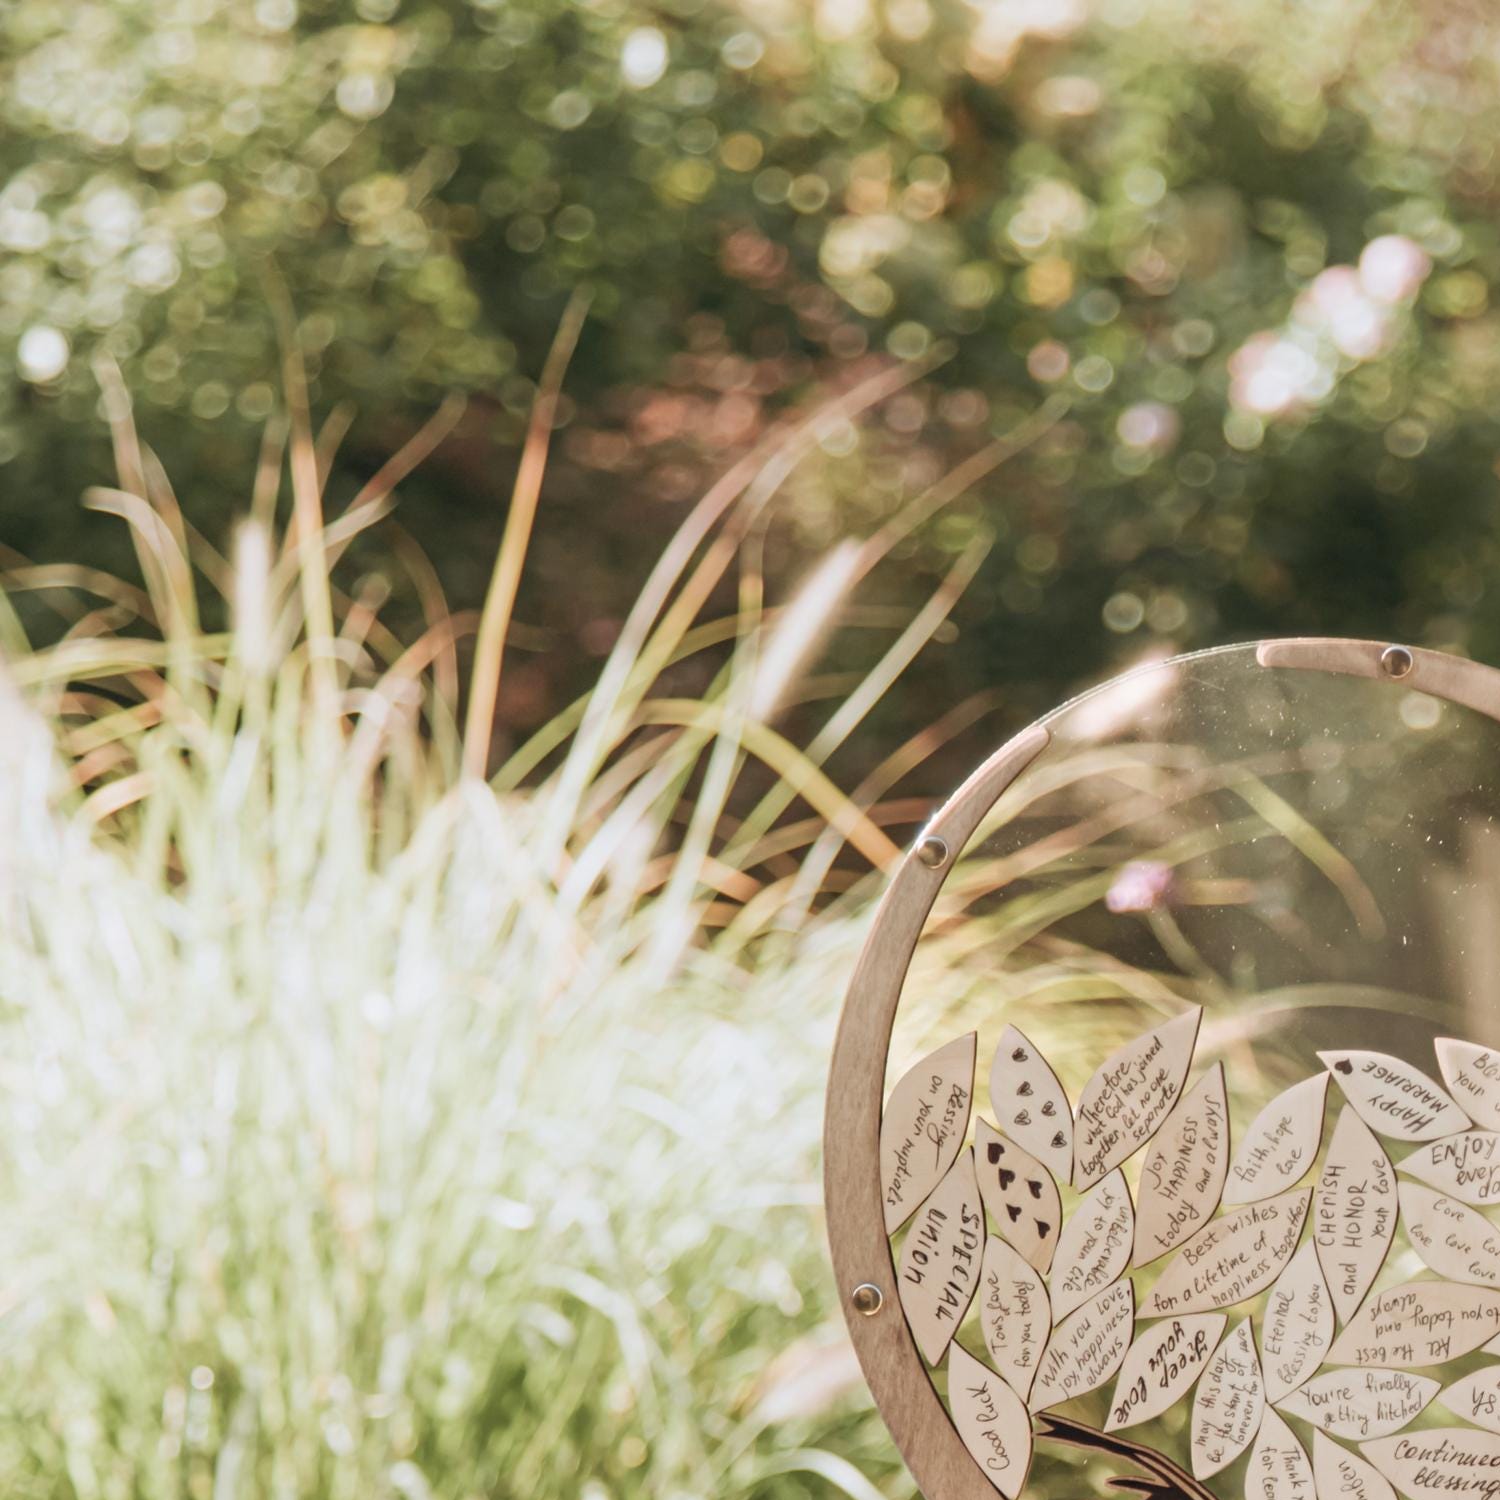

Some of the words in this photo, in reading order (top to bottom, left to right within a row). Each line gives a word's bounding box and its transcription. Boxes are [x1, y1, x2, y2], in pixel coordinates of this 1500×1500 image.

[1138, 1036, 1164, 1083] joined
[929, 1075, 943, 1094] on
[1079, 1061, 1132, 1121] Therefore
[1361, 1060, 1449, 1113] MARRIAGE
[1368, 1094, 1435, 1134] HAPPY
[1160, 1117, 1198, 1200] HAPPINESS
[1373, 1157, 1390, 1194] love
[1154, 1200, 1200, 1248] today
[1195, 1166, 1211, 1193] and
[1228, 1205, 1279, 1234] wishes
[1183, 1289, 1192, 1300] a
[1194, 1252, 1250, 1295] lifetime
[1254, 1230, 1266, 1252] of
[1212, 1259, 1271, 1305] happiness
[1339, 1263, 1357, 1295] and
[1468, 1261, 1496, 1280] love
[1069, 1318, 1092, 1348] you
[1375, 1322, 1402, 1339] and
[1413, 1305, 1454, 1332] today
[1461, 1311, 1483, 1323] you
[981, 1430, 1011, 1471] Good
[1282, 1446, 1303, 1489] Thank
